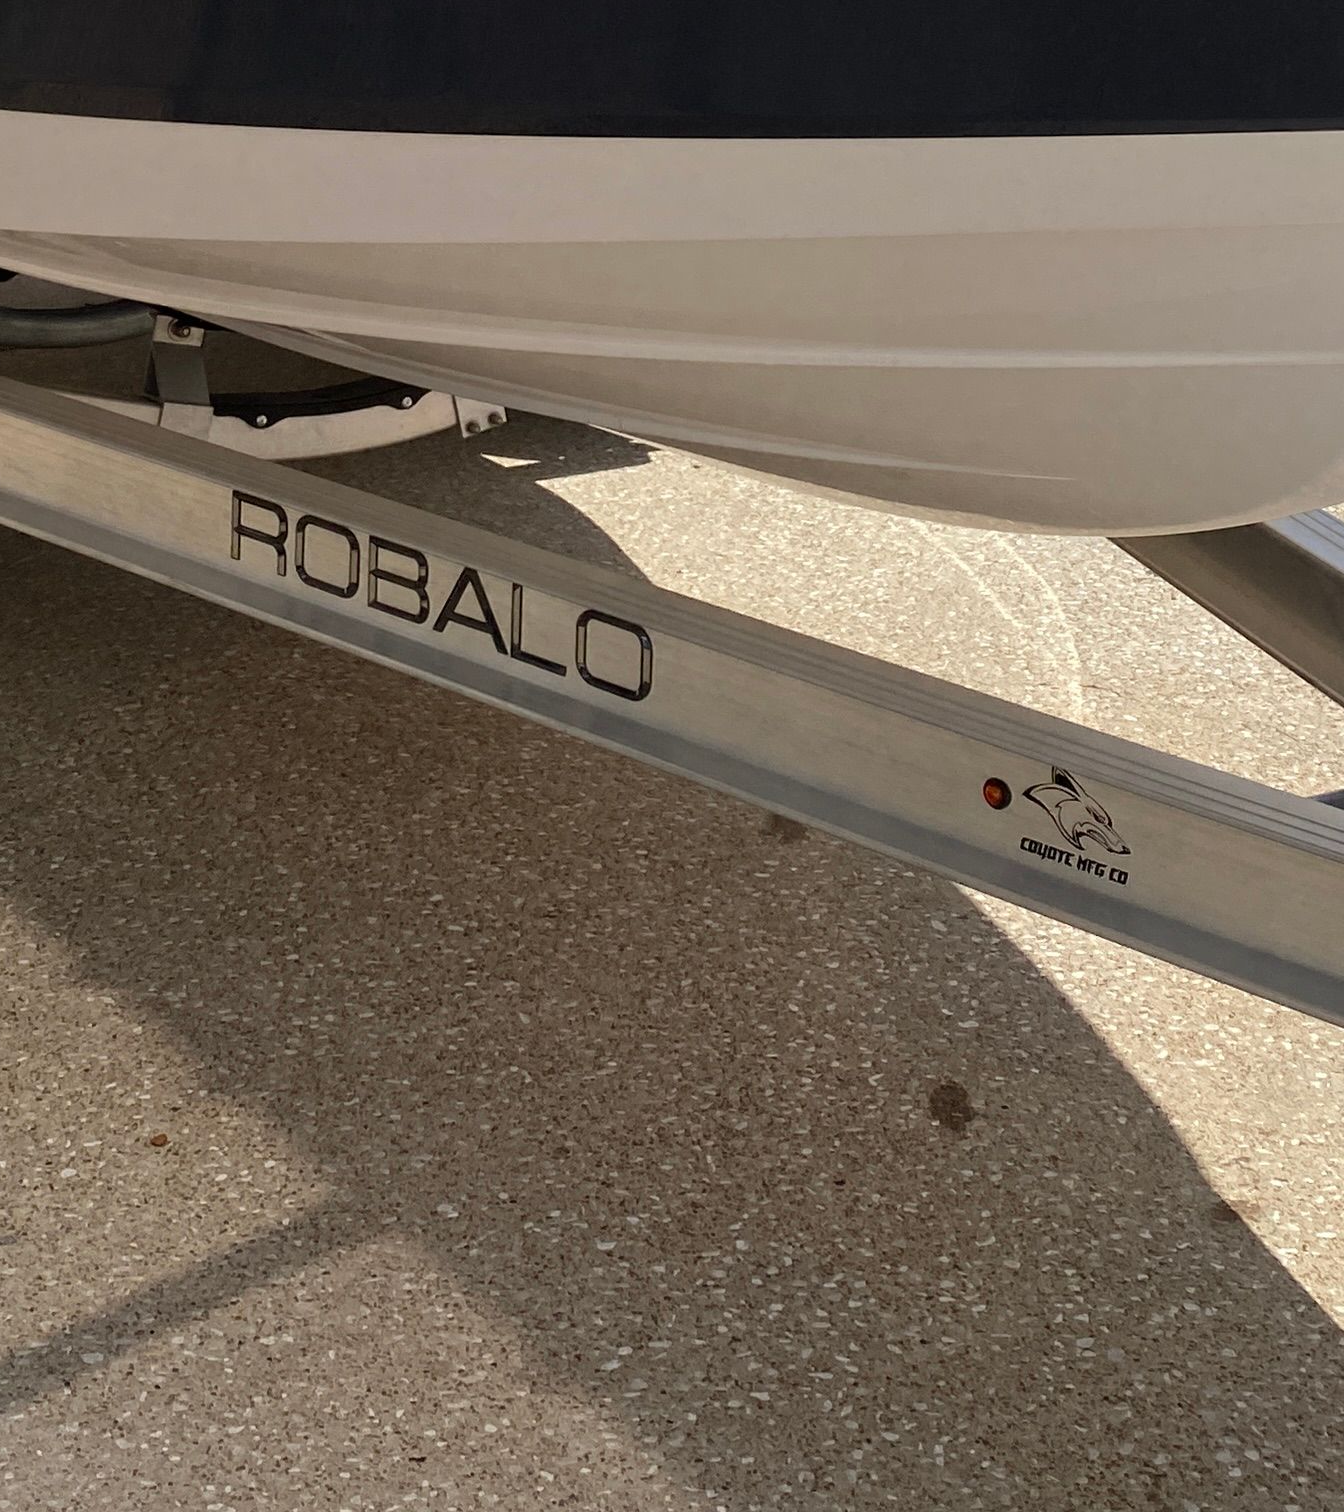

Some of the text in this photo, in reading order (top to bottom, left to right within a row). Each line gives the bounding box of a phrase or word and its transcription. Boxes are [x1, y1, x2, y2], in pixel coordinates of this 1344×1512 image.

[230, 488, 654, 701] ROBALO
[1019, 837, 1129, 886] COYOTE MFG CO
